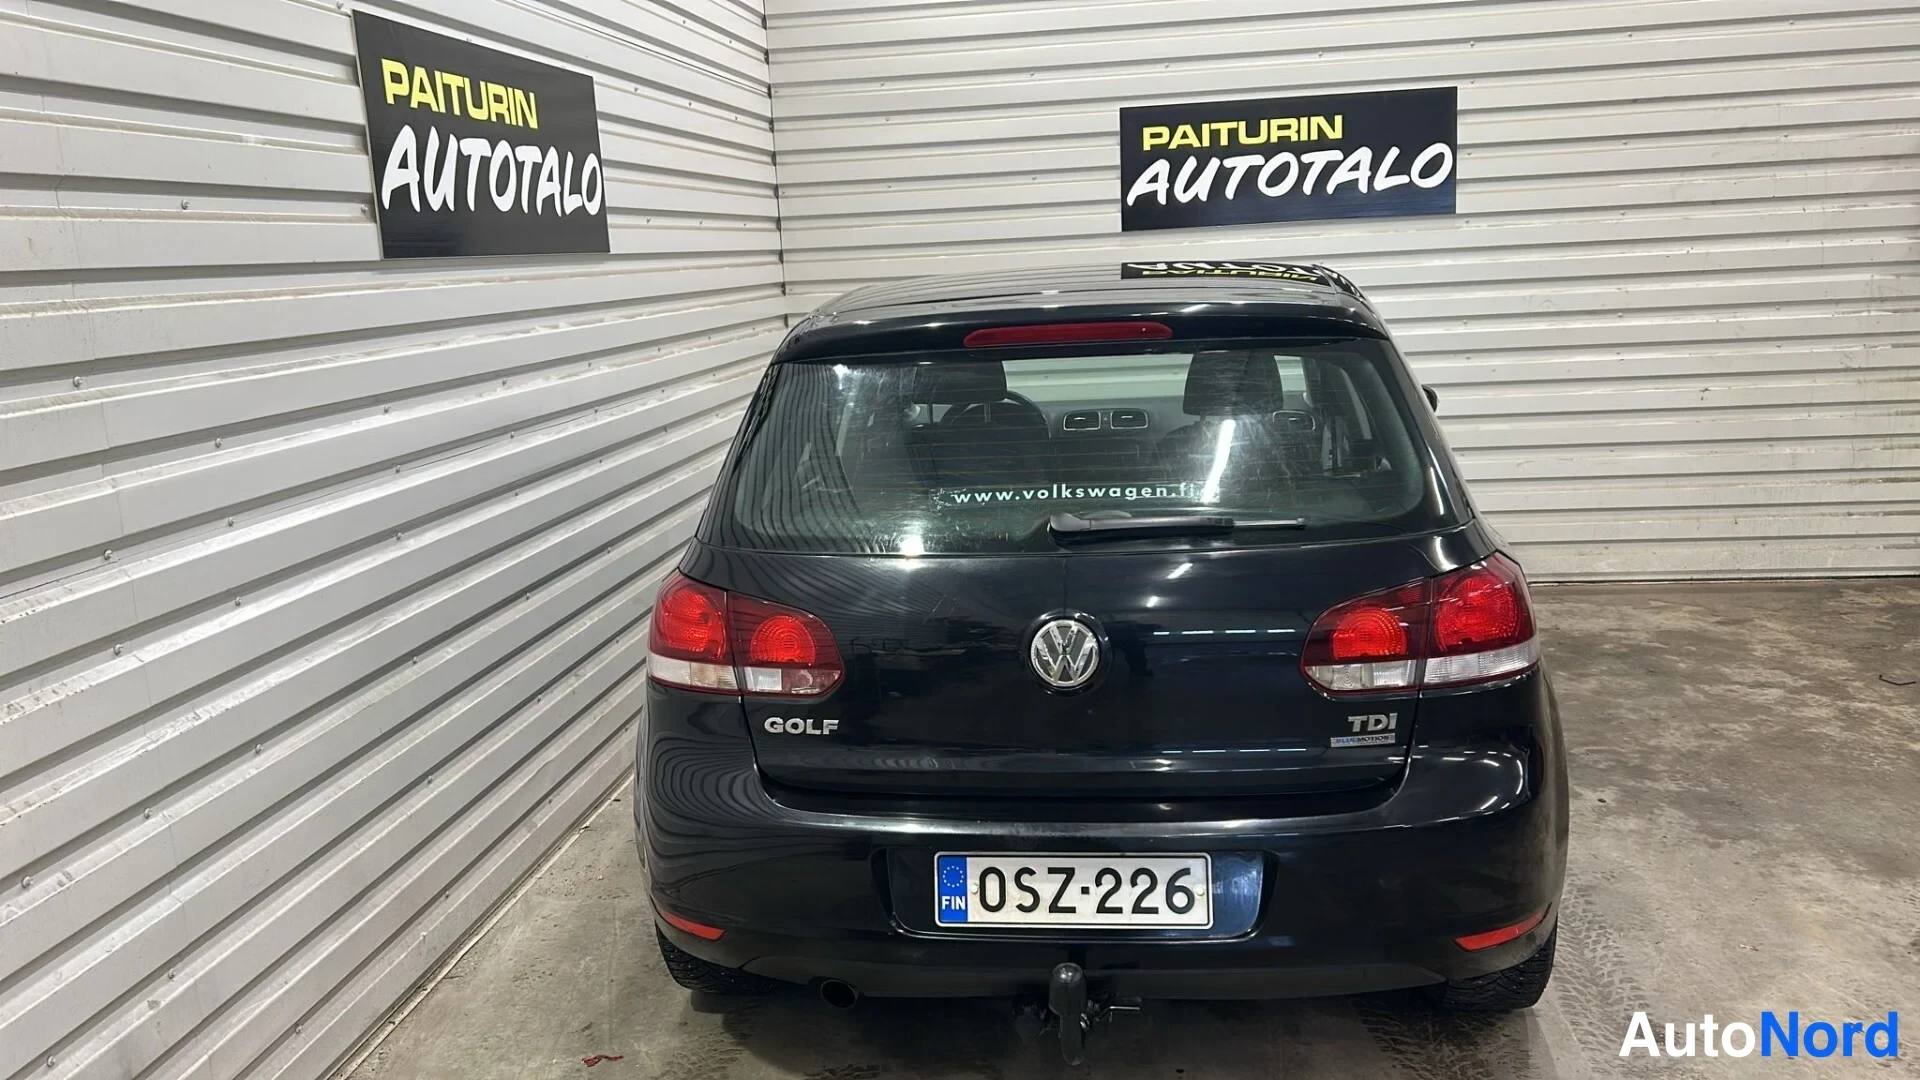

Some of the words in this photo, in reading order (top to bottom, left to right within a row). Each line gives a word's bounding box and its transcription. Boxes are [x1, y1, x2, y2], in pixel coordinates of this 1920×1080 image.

[381, 58, 538, 129] PAITURIN
[1142, 114, 1344, 151] PAITURIN
[381, 124, 602, 217] AUTOTALO
[1126, 142, 1454, 207] AUTOTALO
[952, 482, 1194, 504] www.volkswagen.fi
[763, 716, 840, 735] GOLF
[1347, 712, 1398, 733] TDI
[941, 895, 966, 910] FIN
[978, 866, 1195, 915] OSZ-226
